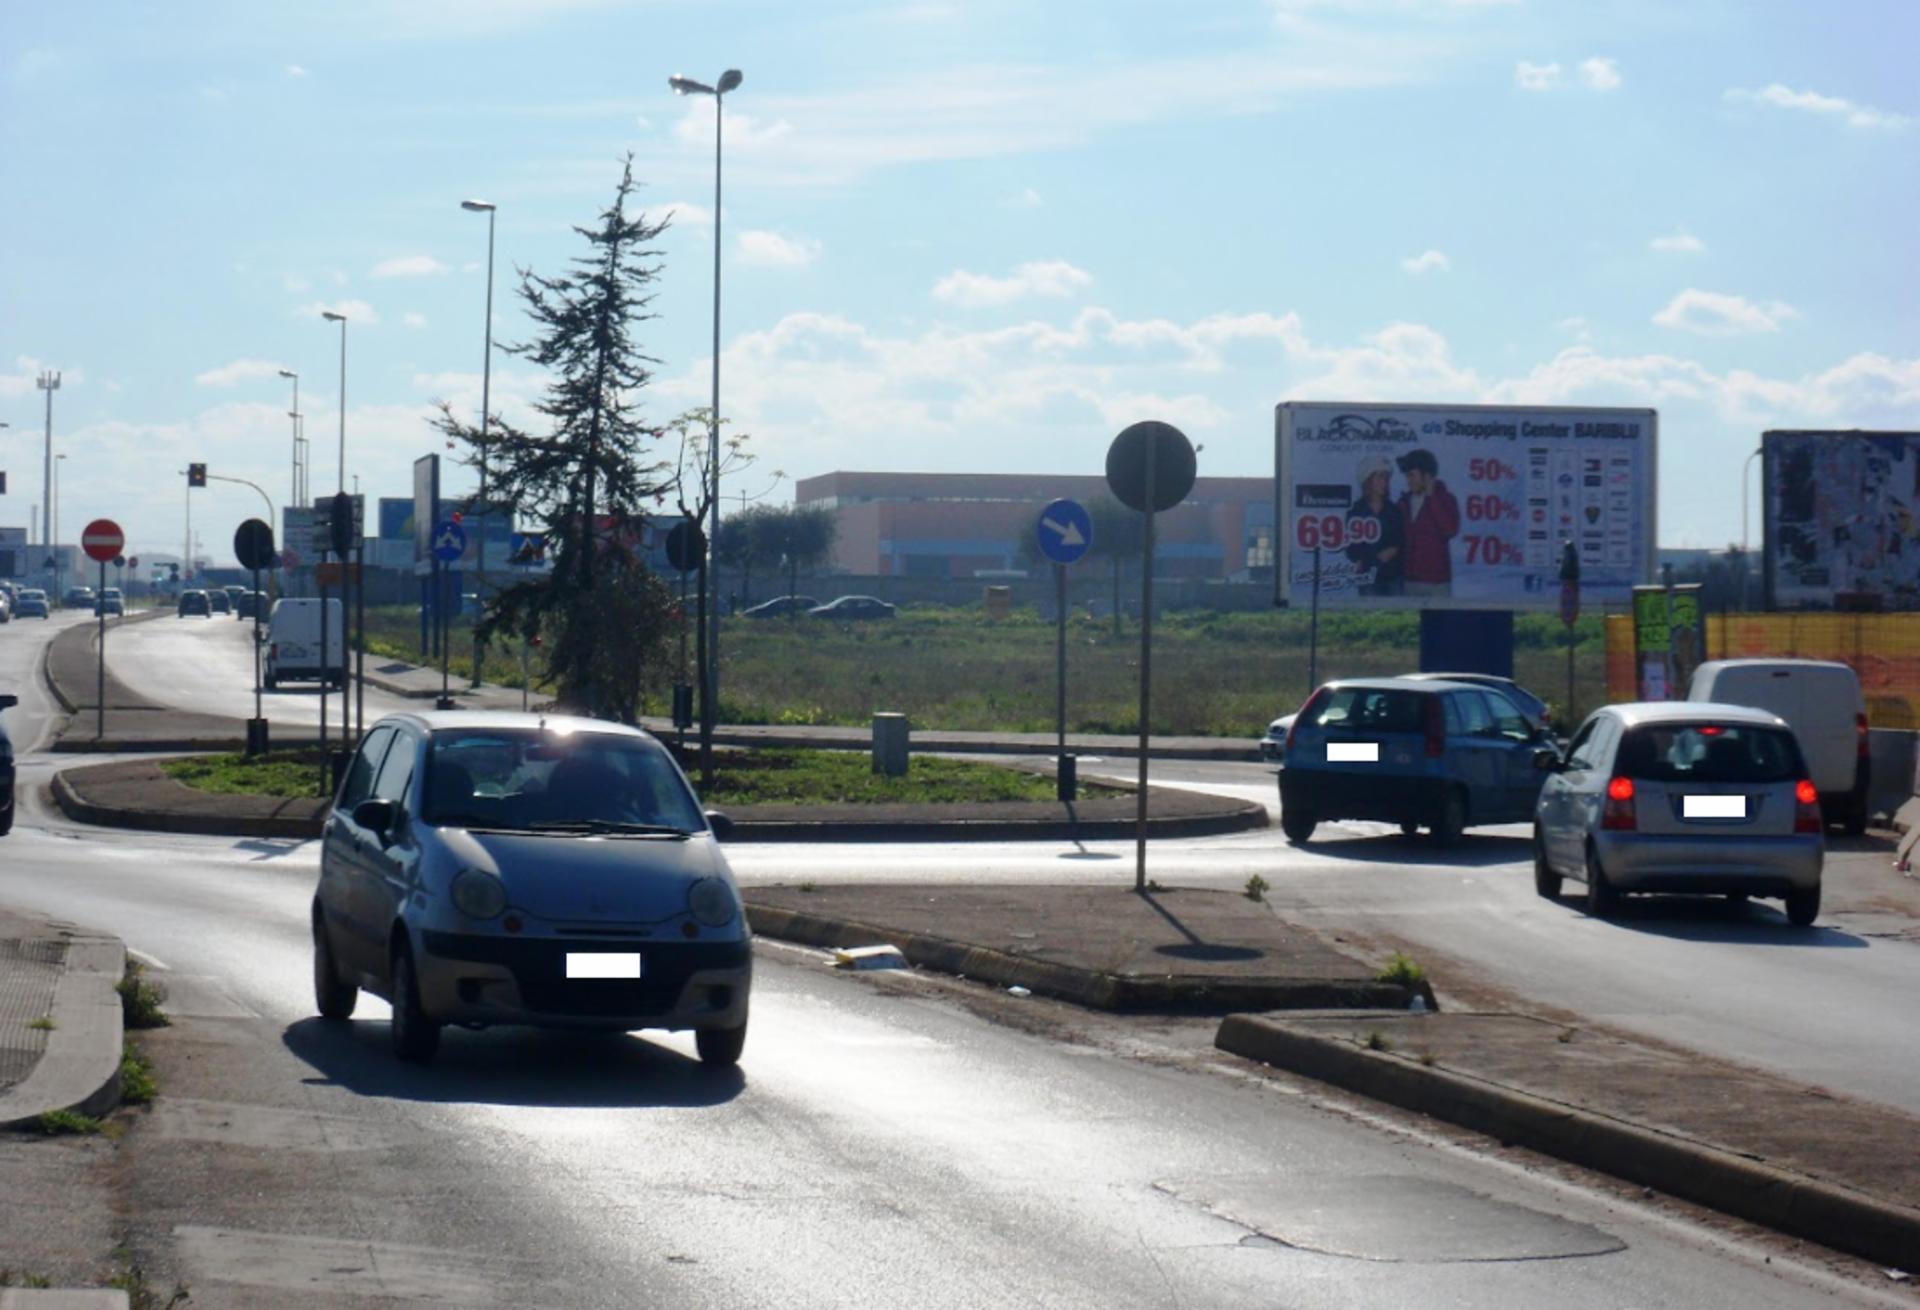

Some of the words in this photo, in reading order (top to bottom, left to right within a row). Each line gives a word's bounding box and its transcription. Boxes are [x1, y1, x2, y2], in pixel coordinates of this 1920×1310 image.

[1445, 419, 1517, 441] Shopping
[1521, 421, 1570, 438] Center
[1574, 422, 1640, 439] BARIBLU
[1468, 459, 1517, 481] 50%
[1466, 494, 1520, 521] 60%
[1462, 535, 1524, 565] 70%
